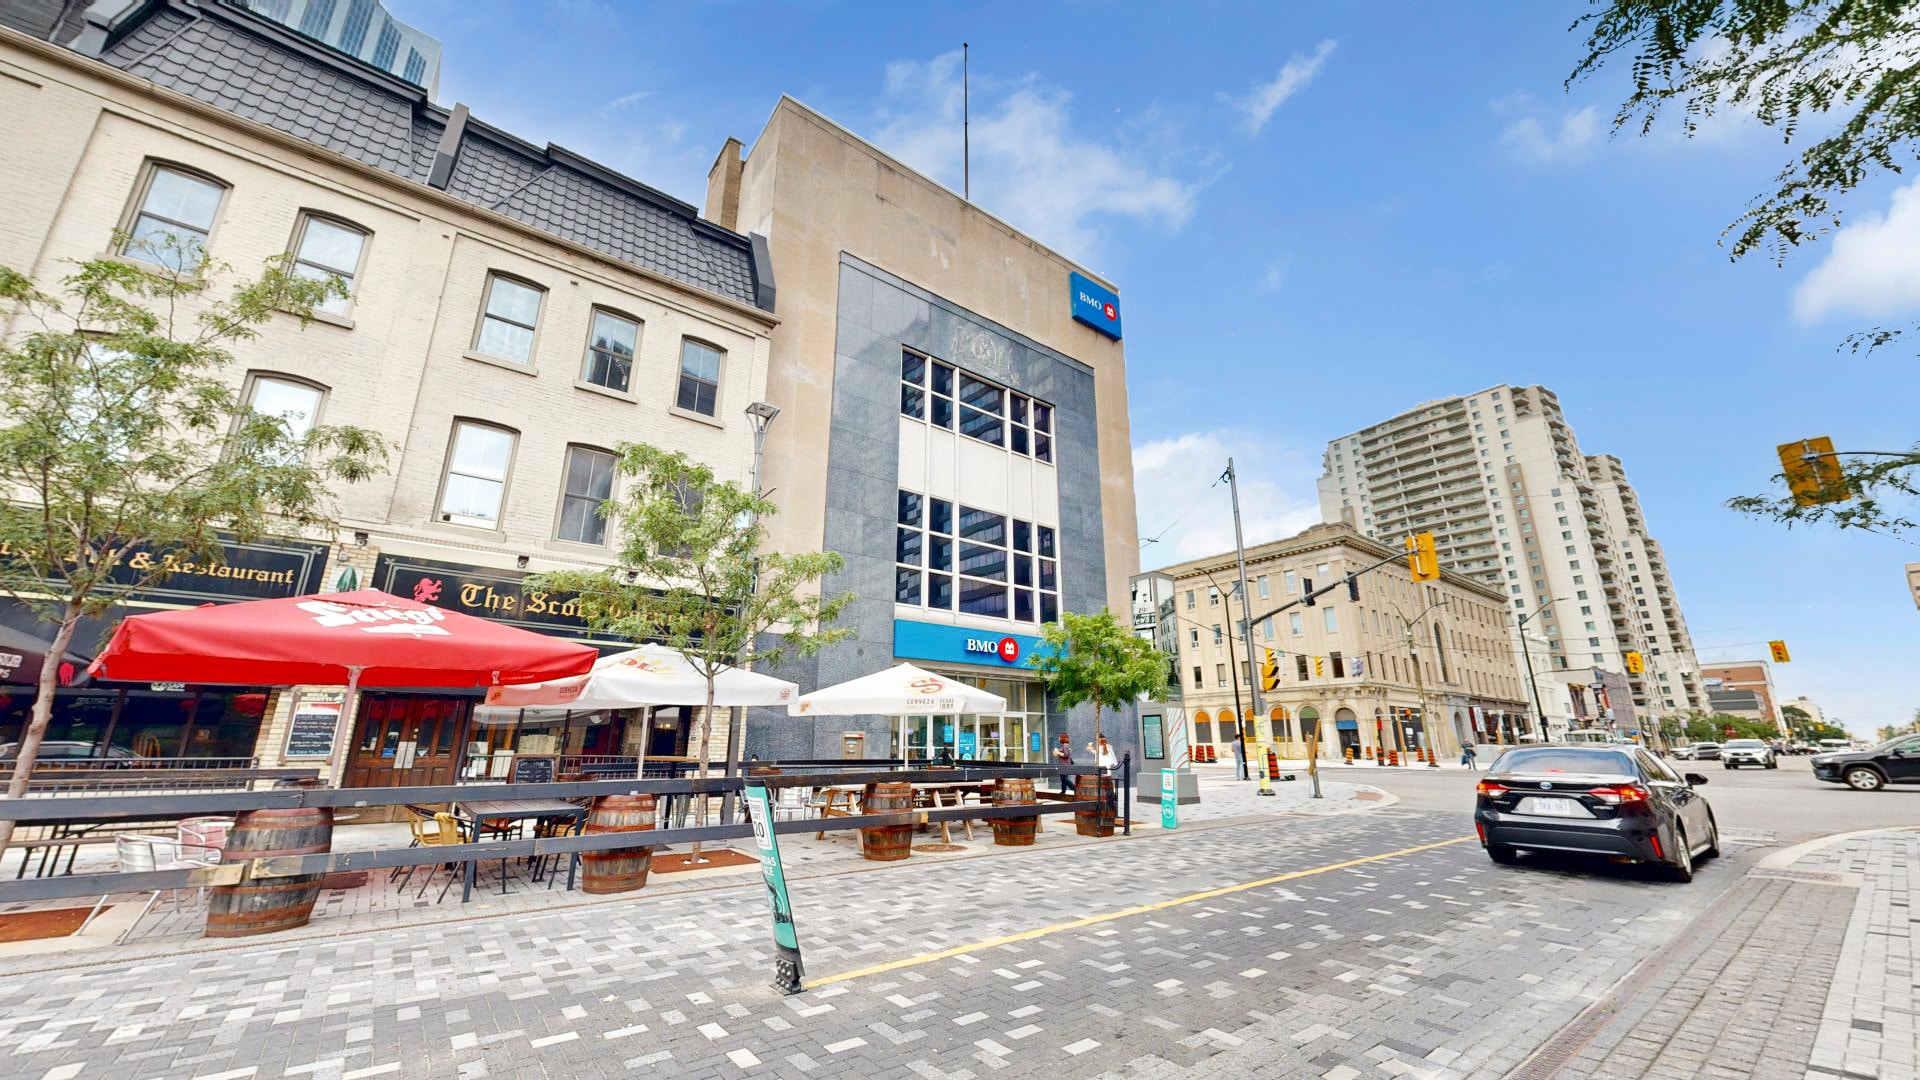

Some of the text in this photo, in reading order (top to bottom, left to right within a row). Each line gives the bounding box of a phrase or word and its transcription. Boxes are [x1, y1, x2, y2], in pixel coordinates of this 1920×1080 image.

[1080, 291, 1102, 310] BMO
[460, 583, 516, 613] The
[967, 638, 998, 653] BMO
[754, 821, 765, 838] 20
